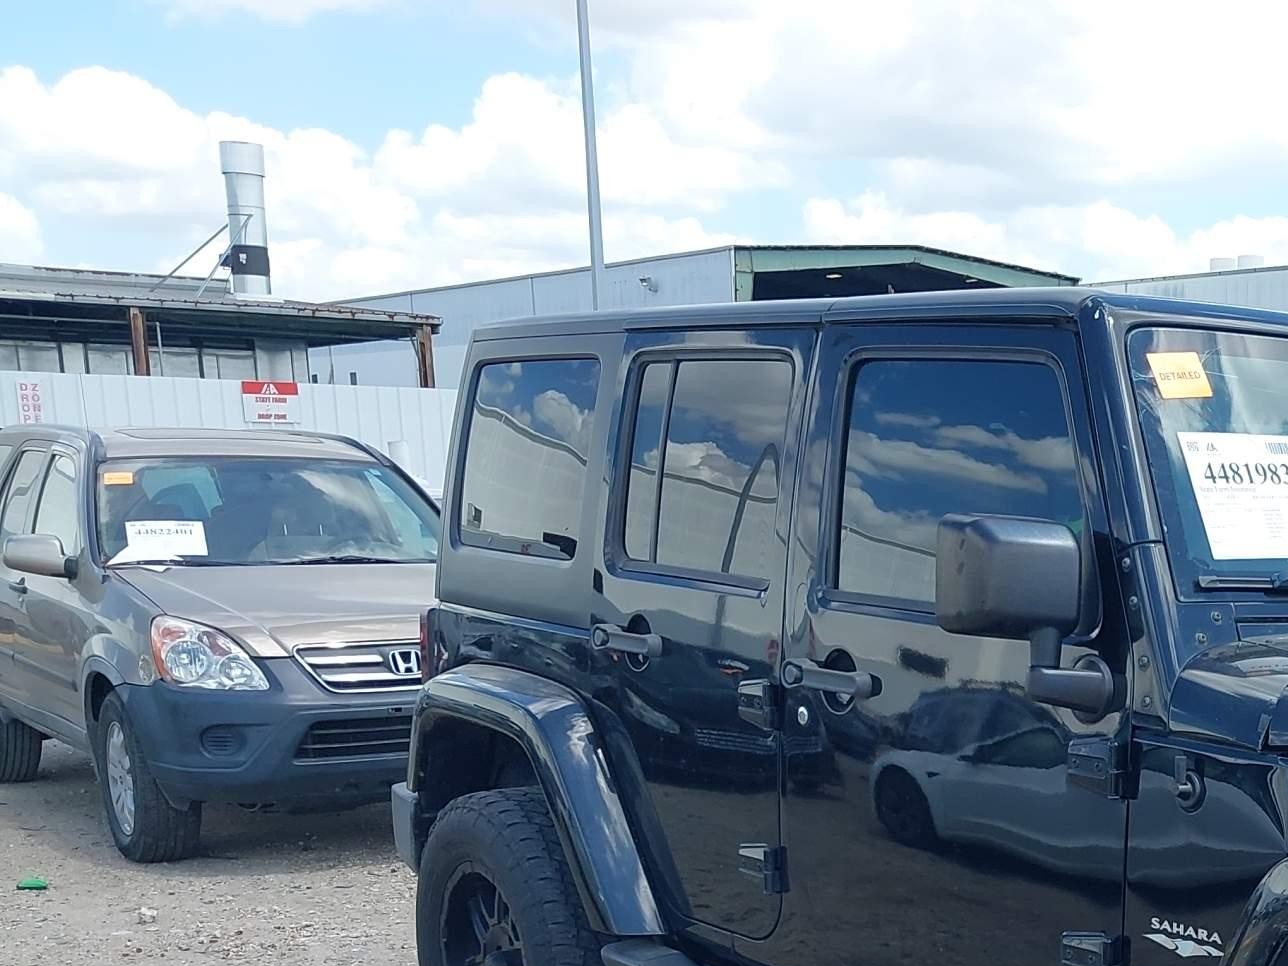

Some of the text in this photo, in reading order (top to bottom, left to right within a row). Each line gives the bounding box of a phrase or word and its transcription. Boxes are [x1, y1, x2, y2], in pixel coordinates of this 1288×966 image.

[1159, 370, 1201, 381] DETAILED
[20, 383, 31, 424] DROP
[1151, 917, 1222, 945] SAHARA
